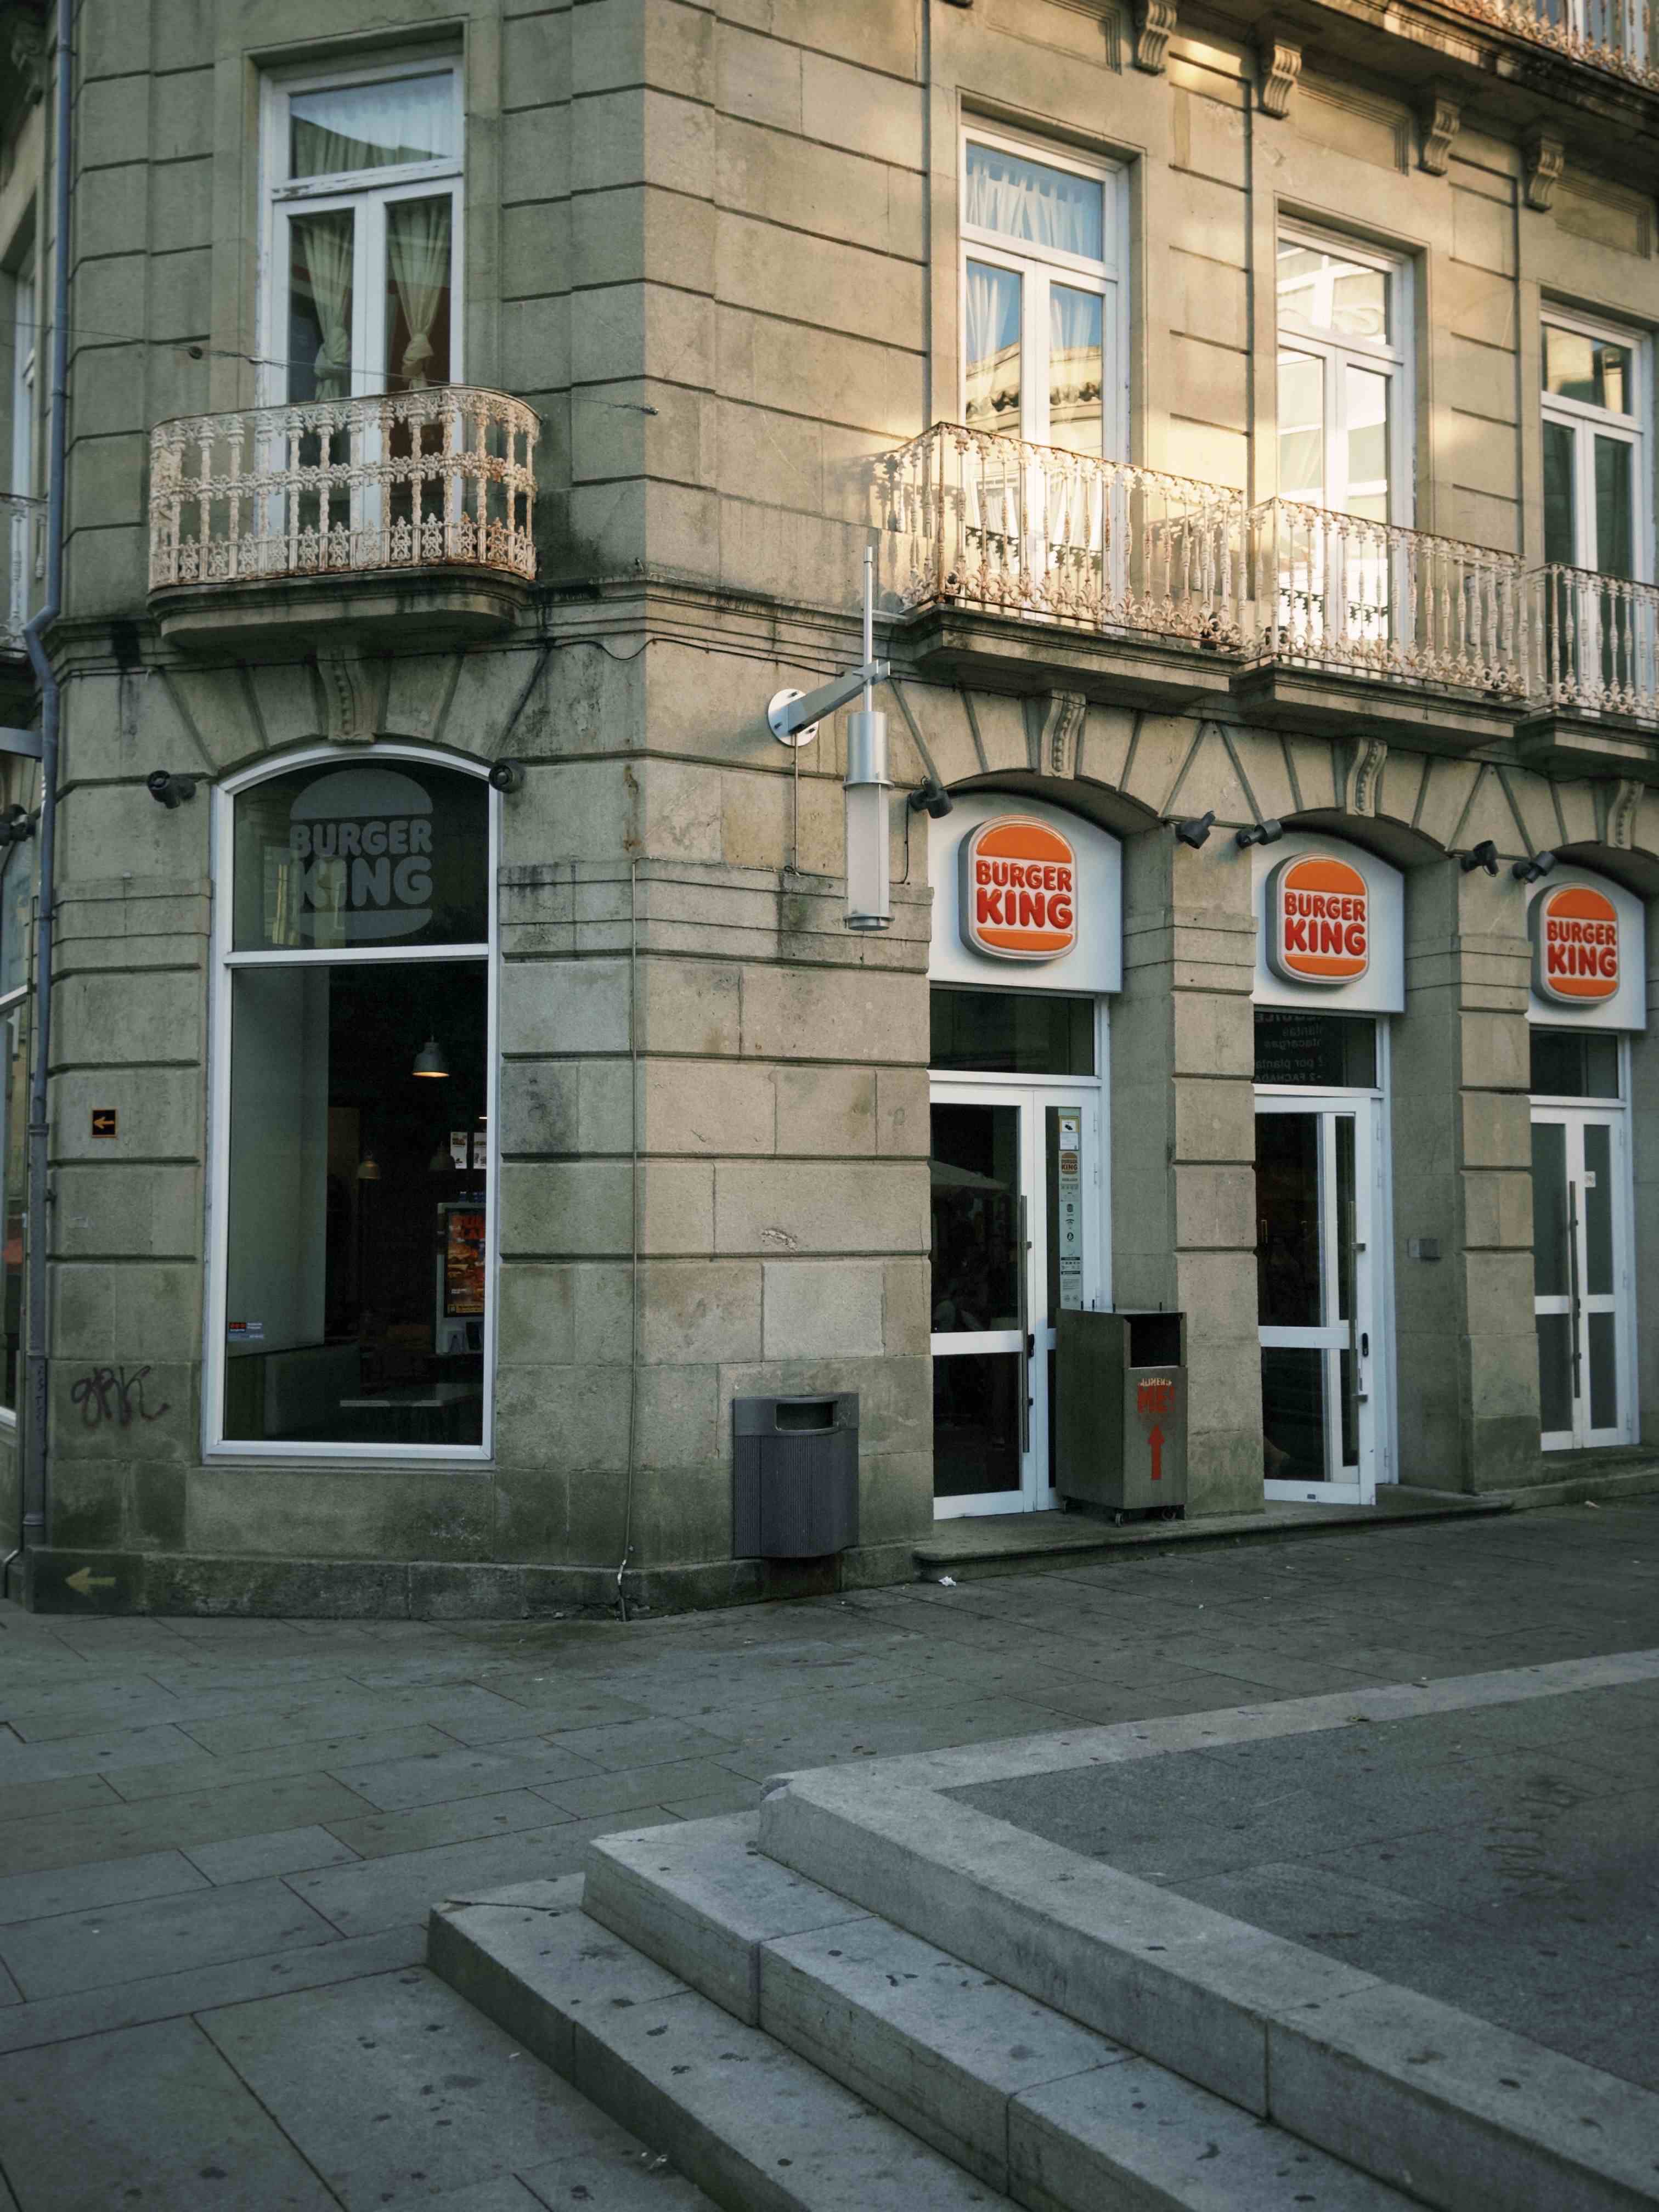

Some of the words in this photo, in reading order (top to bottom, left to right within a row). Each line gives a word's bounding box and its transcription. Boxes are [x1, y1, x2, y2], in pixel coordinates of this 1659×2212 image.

[290, 820, 433, 857] BURGER
[291, 855, 433, 909] KING
[975, 860, 1072, 893] BURGER
[976, 887, 1073, 929] KING
[1284, 892, 1366, 922] BURGER
[1285, 917, 1366, 956] KING
[1547, 920, 1617, 946] BURGER
[1547, 943, 1617, 978] KING
